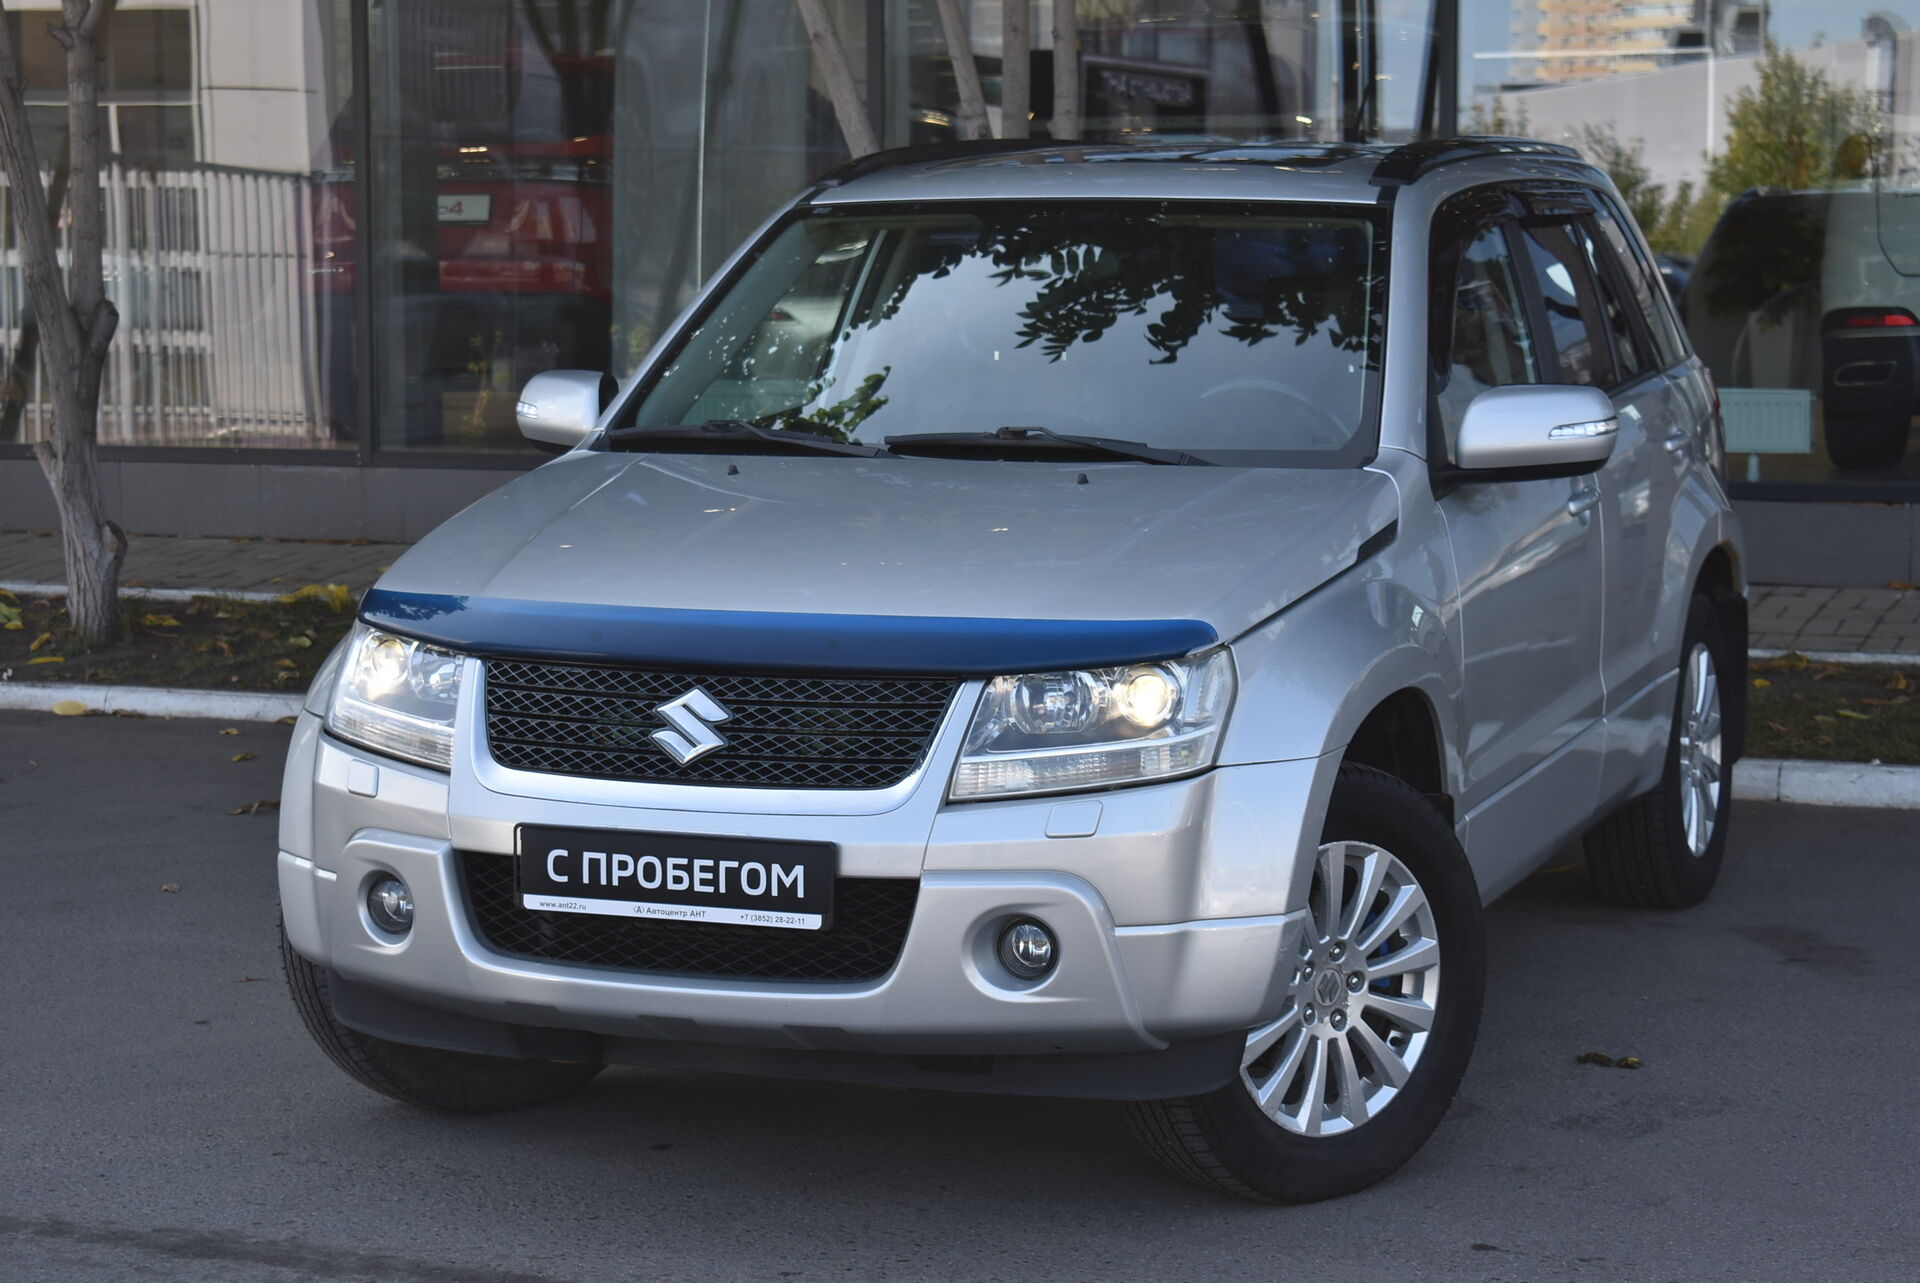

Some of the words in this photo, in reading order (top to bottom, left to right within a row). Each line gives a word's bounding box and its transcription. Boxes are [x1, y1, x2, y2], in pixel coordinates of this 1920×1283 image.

[546, 849, 569, 883] С
[582, 851, 805, 898] ПРОБЕГОМ
[539, 900, 587, 911] www.ant22.ru
[646, 907, 688, 918] Автоцентр
[689, 910, 707, 919] АНТ
[740, 913, 749, 921] +7
[750, 914, 773, 924] (3852)
[774, 916, 805, 925] 28-22-11
